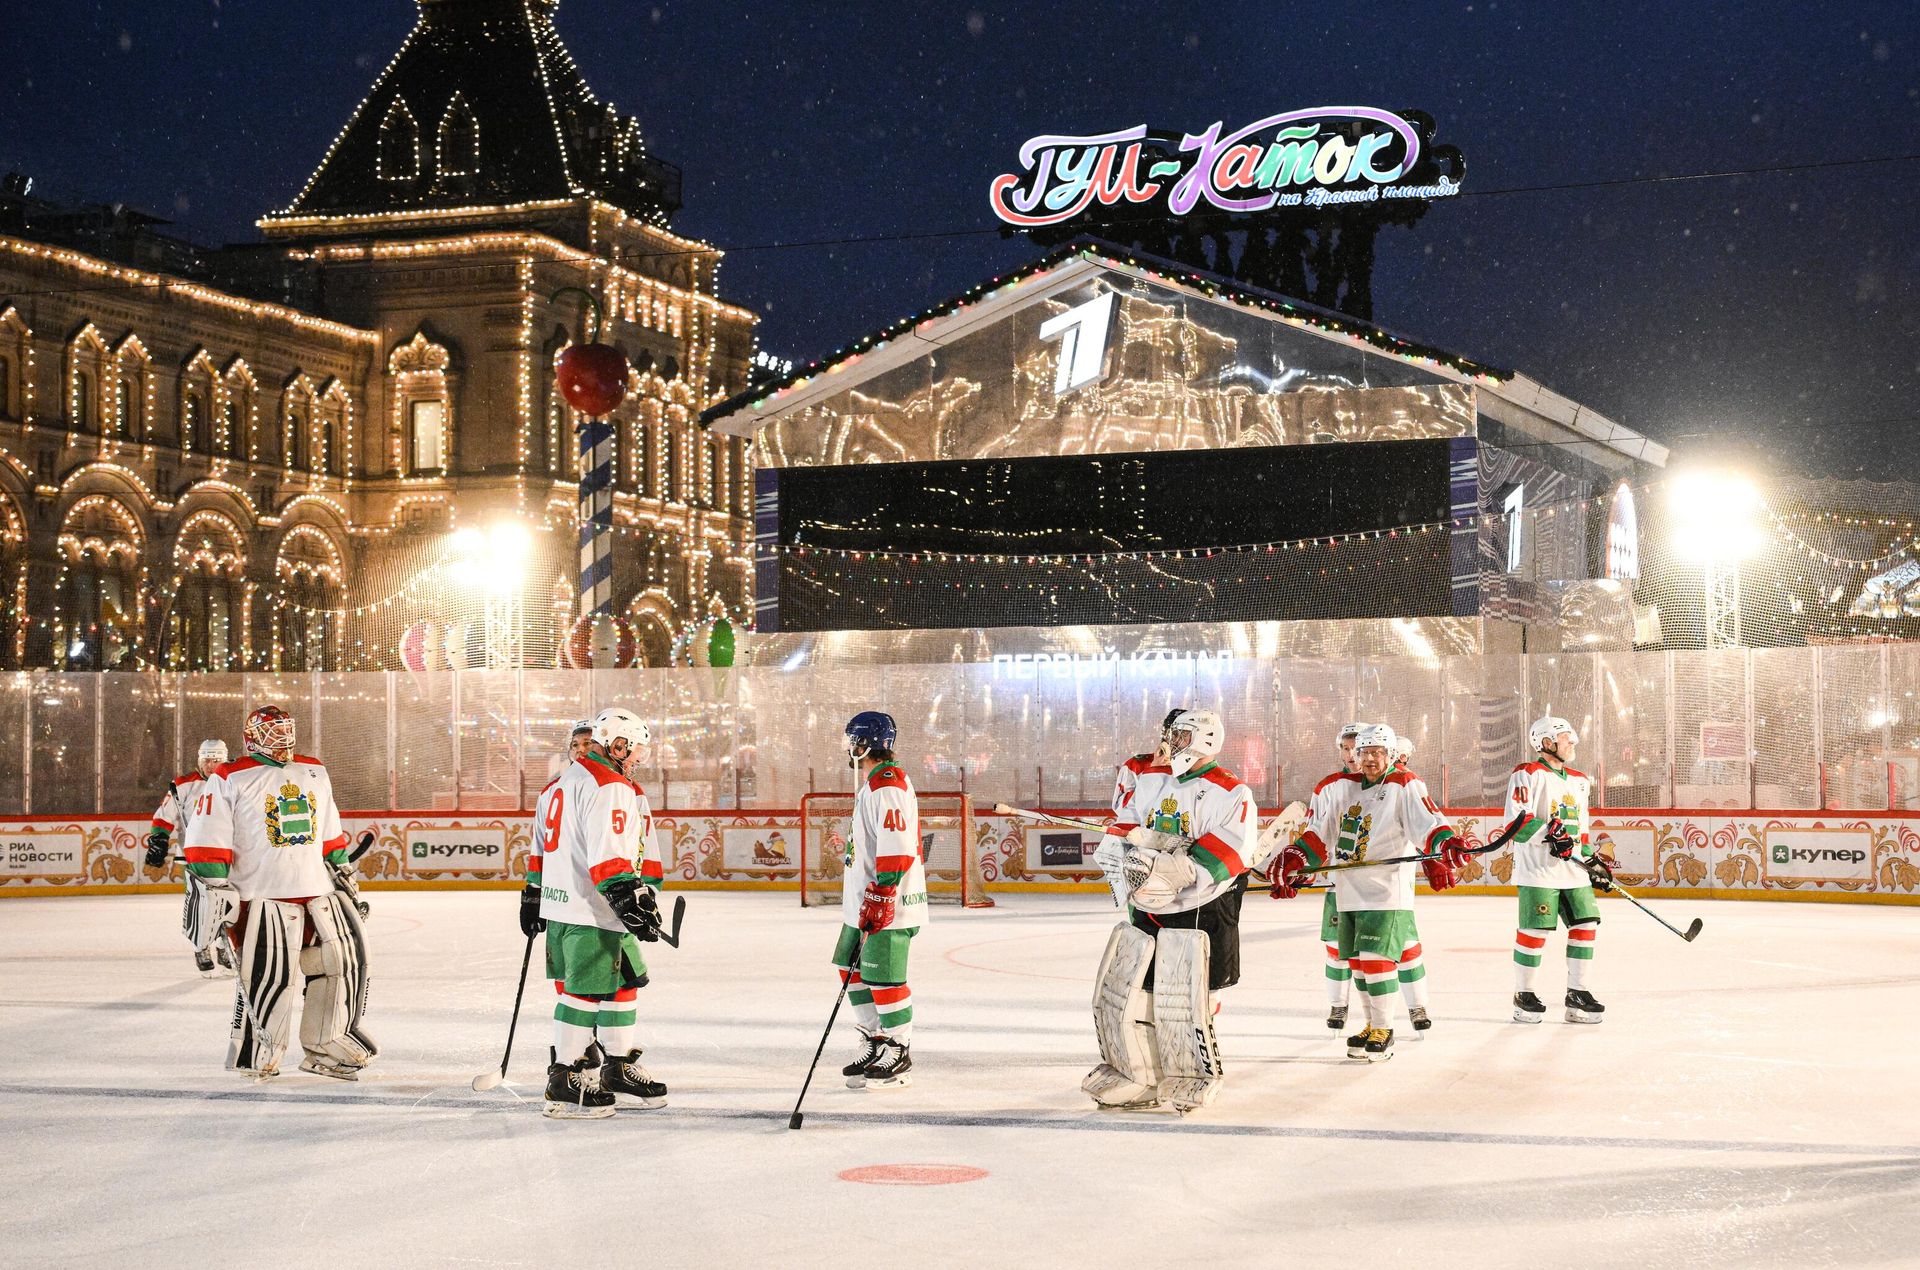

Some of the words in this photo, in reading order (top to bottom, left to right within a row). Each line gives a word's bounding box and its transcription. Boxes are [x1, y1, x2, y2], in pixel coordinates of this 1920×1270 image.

[1277, 192, 1302, 207] на
[1303, 185, 1380, 210] Красной
[1382, 175, 1461, 202] площади
[993, 646, 1120, 681] ПЕРВЫЙ
[1129, 650, 1234, 678] КАНАЛ
[196, 793, 214, 816] 91
[1511, 786, 1529, 804] 40
[883, 808, 906, 833] 40
[9, 842, 36, 852] РИА
[9, 852, 74, 863] НОВОСТИ
[430, 844, 500, 857] купер
[1791, 848, 1866, 864] купер
[1195, 1028, 1214, 1076] CCM
[1208, 1024, 1224, 1076] CCM
